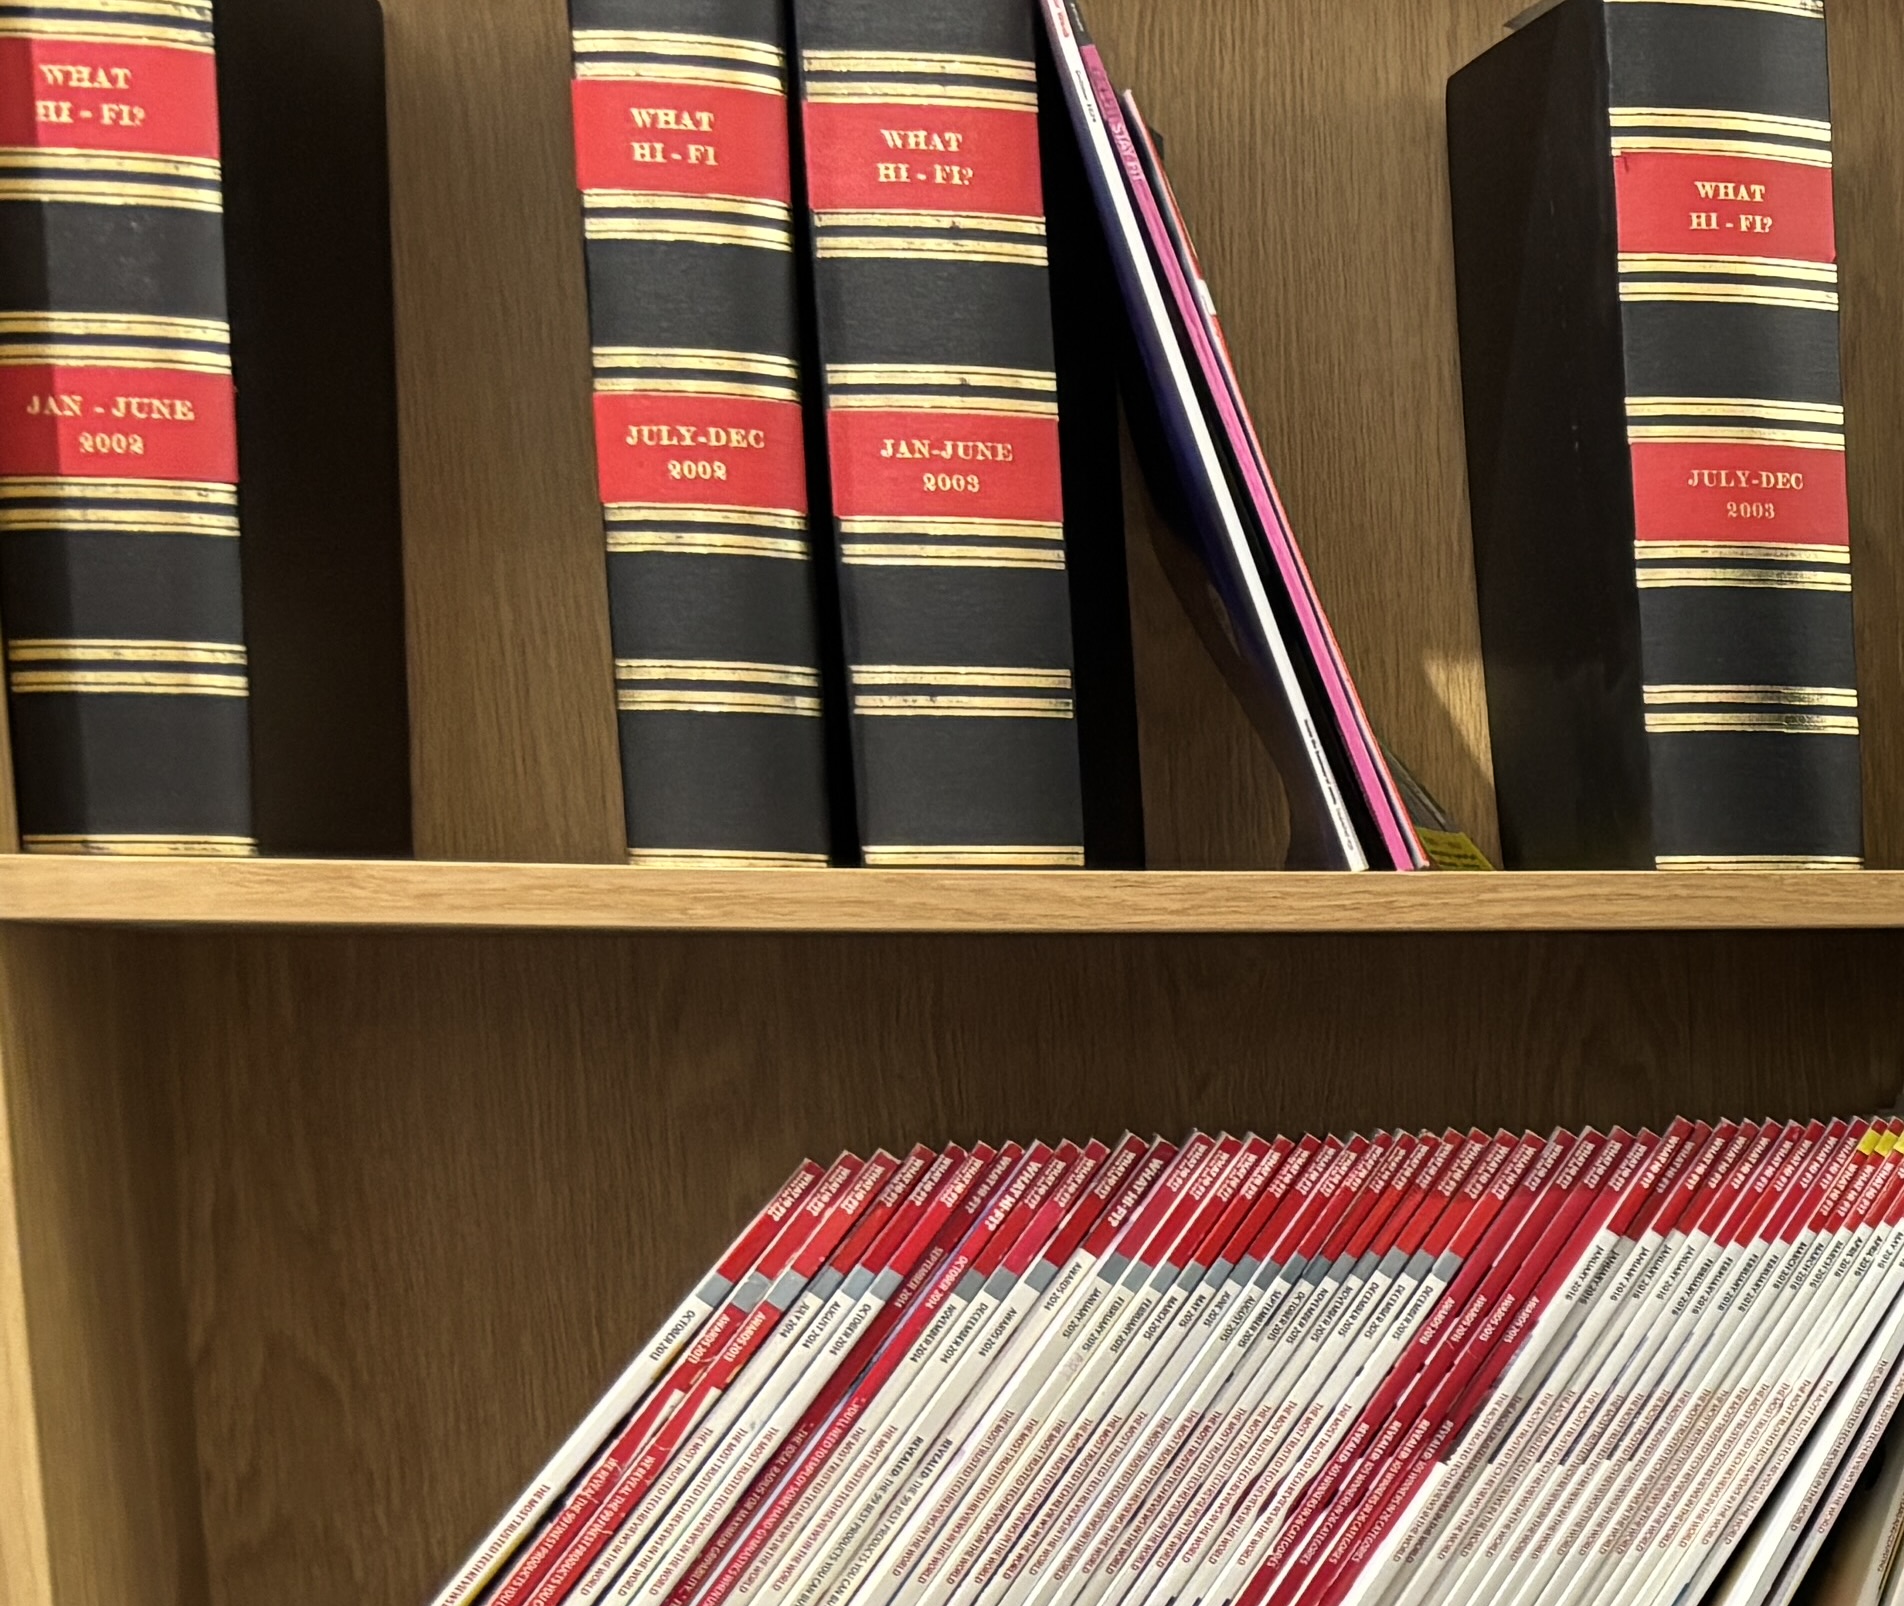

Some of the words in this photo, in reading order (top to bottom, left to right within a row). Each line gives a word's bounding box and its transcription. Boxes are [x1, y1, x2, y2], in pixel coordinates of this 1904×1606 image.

[39, 64, 132, 88] WHAT
[630, 107, 715, 132] WHAT
[880, 129, 962, 152] WHAT
[1694, 180, 1766, 202] WHAT
[79, 432, 144, 454] 2002
[626, 425, 765, 449] JULY-DEC
[880, 439, 1013, 463] JAN-JUNE
[667, 460, 727, 481] 2002
[1687, 469, 1804, 490] JULY-DEC
[922, 474, 980, 493] 2003
[1726, 501, 1775, 520] 2003
[1621, 1245, 1649, 1284] JANUARY
[1820, 1238, 1843, 1270] MARCH
[939, 1253, 969, 1289] OCTOBER
[1700, 1255, 1733, 1302] FEBRUARY
[1072, 1286, 1101, 1322] JANUARY
[1091, 1294, 1124, 1336] FEBRUARY
[1152, 1293, 1178, 1325] MARCH
[1230, 1294, 1256, 1326] AUGUST
[921, 1302, 957, 1346] NOVEMBER
[990, 1306, 1018, 1339] AWARDS
